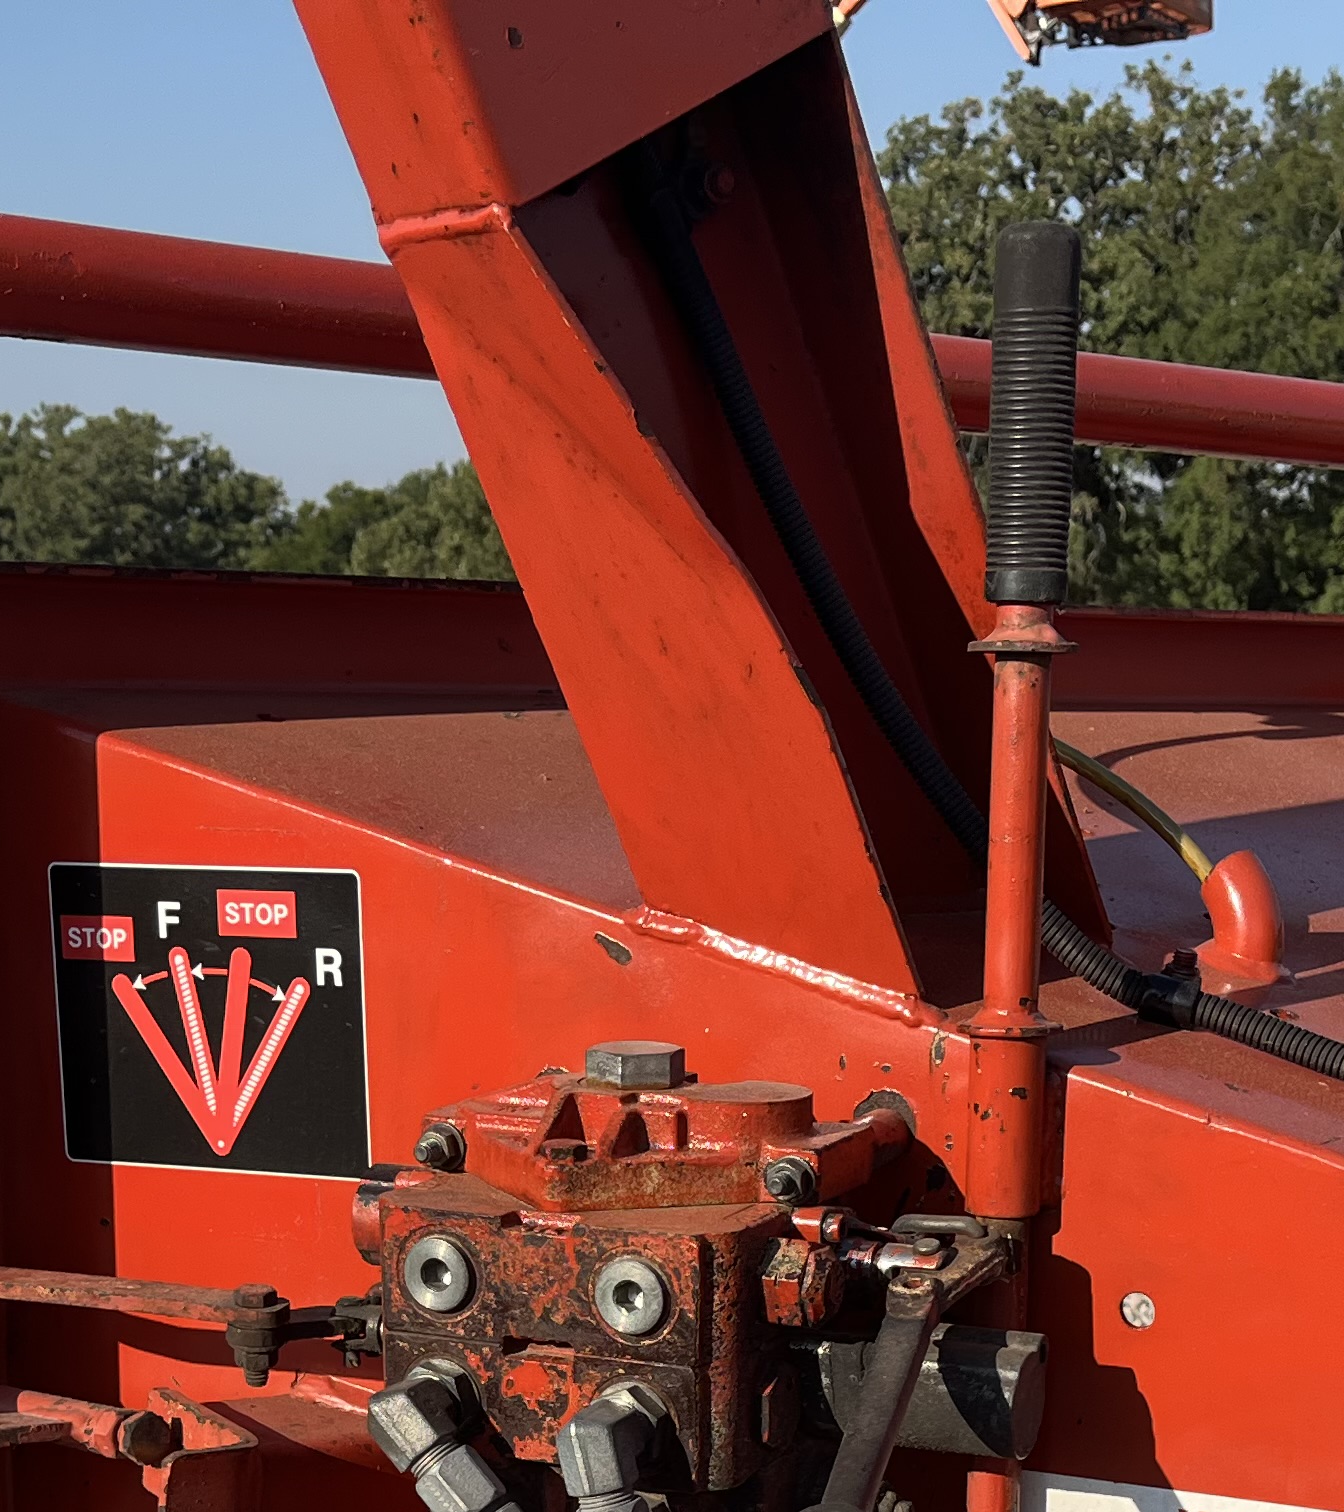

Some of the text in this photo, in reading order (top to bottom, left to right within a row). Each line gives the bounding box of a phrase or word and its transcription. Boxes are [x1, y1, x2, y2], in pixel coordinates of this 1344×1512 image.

[157, 901, 181, 939] F
[225, 903, 289, 925] STOP
[68, 927, 127, 949] STOP
[315, 948, 343, 987] R
